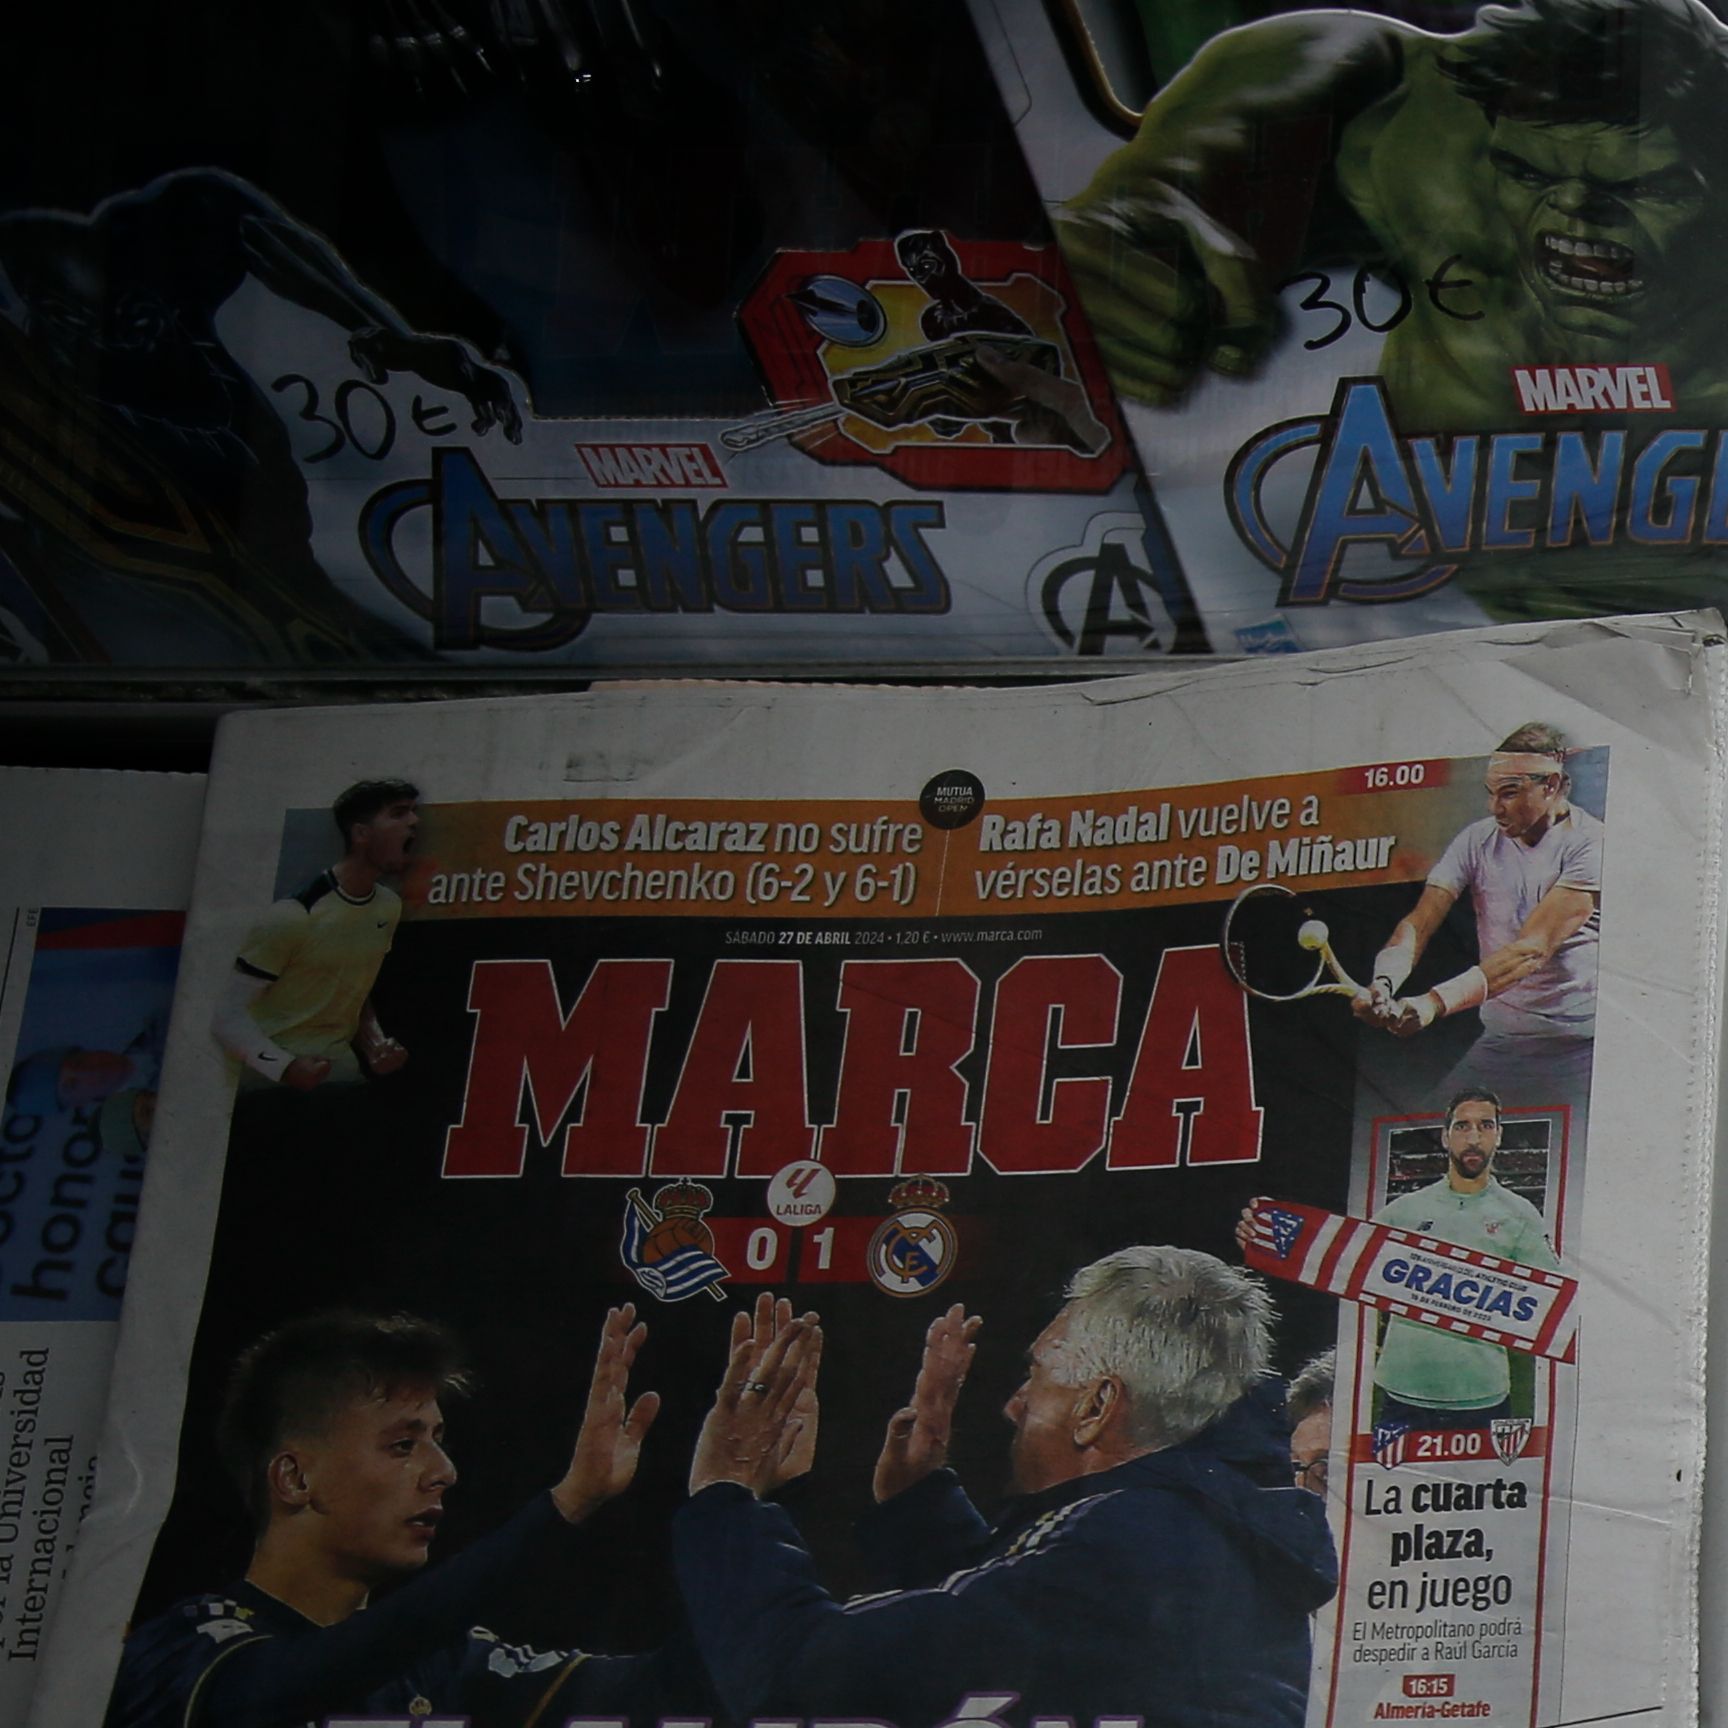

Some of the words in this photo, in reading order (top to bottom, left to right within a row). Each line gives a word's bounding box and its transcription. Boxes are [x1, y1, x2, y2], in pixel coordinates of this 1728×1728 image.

[1511, 366, 1672, 410] MARVEL
[577, 443, 725, 488] MARVEL
[361, 447, 951, 650] AVENGERS
[1364, 764, 1424, 786] 16.00
[504, 815, 619, 854] Carlos
[625, 814, 766, 852] Alcaraz
[773, 821, 820, 852] no
[829, 818, 923, 854] sufre
[979, 811, 1062, 852] Rafa
[1069, 804, 1171, 848] Nadal
[1178, 796, 1291, 840] vuelve
[1299, 795, 1319, 828] a
[428, 866, 504, 904] ante
[514, 864, 734, 901] Shevchenko
[745, 864, 812, 904] (6-2
[824, 872, 844, 906] y
[854, 864, 916, 905] 6-1)
[975, 860, 1121, 901] vérselas
[1130, 855, 1206, 892] ante
[1215, 844, 1260, 886] De
[1266, 835, 1396, 879] Miñaur
[441, 941, 1264, 1180] MARCA
[775, 1202, 822, 1218] LALIGA
[747, 1228, 778, 1270] 0
[812, 1227, 831, 1269] 1
[1381, 1258, 1539, 1322] GRACIAS
[0, 1345, 52, 1543] Universidad
[1417, 1432, 1481, 1456] 21.00
[1365, 1479, 1402, 1516] La
[1411, 1477, 1527, 1513] cuarta
[7, 1433, 74, 1664] Internacional
[1391, 1523, 1494, 1566] plaza,
[1368, 1579, 1407, 1610] en
[1416, 1572, 1512, 1613] juego
[1353, 1622, 1366, 1640] El
[1370, 1621, 1475, 1642] Metropolitano
[1479, 1617, 1522, 1639] podrá
[1353, 1643, 1416, 1666] despedir
[1421, 1646, 1430, 1661] a
[1435, 1640, 1467, 1661] Raúl
[1471, 1639, 1518, 1660] García
[1409, 1679, 1448, 1694] 16:15
[1374, 1701, 1491, 1720] Almería-Getafe
